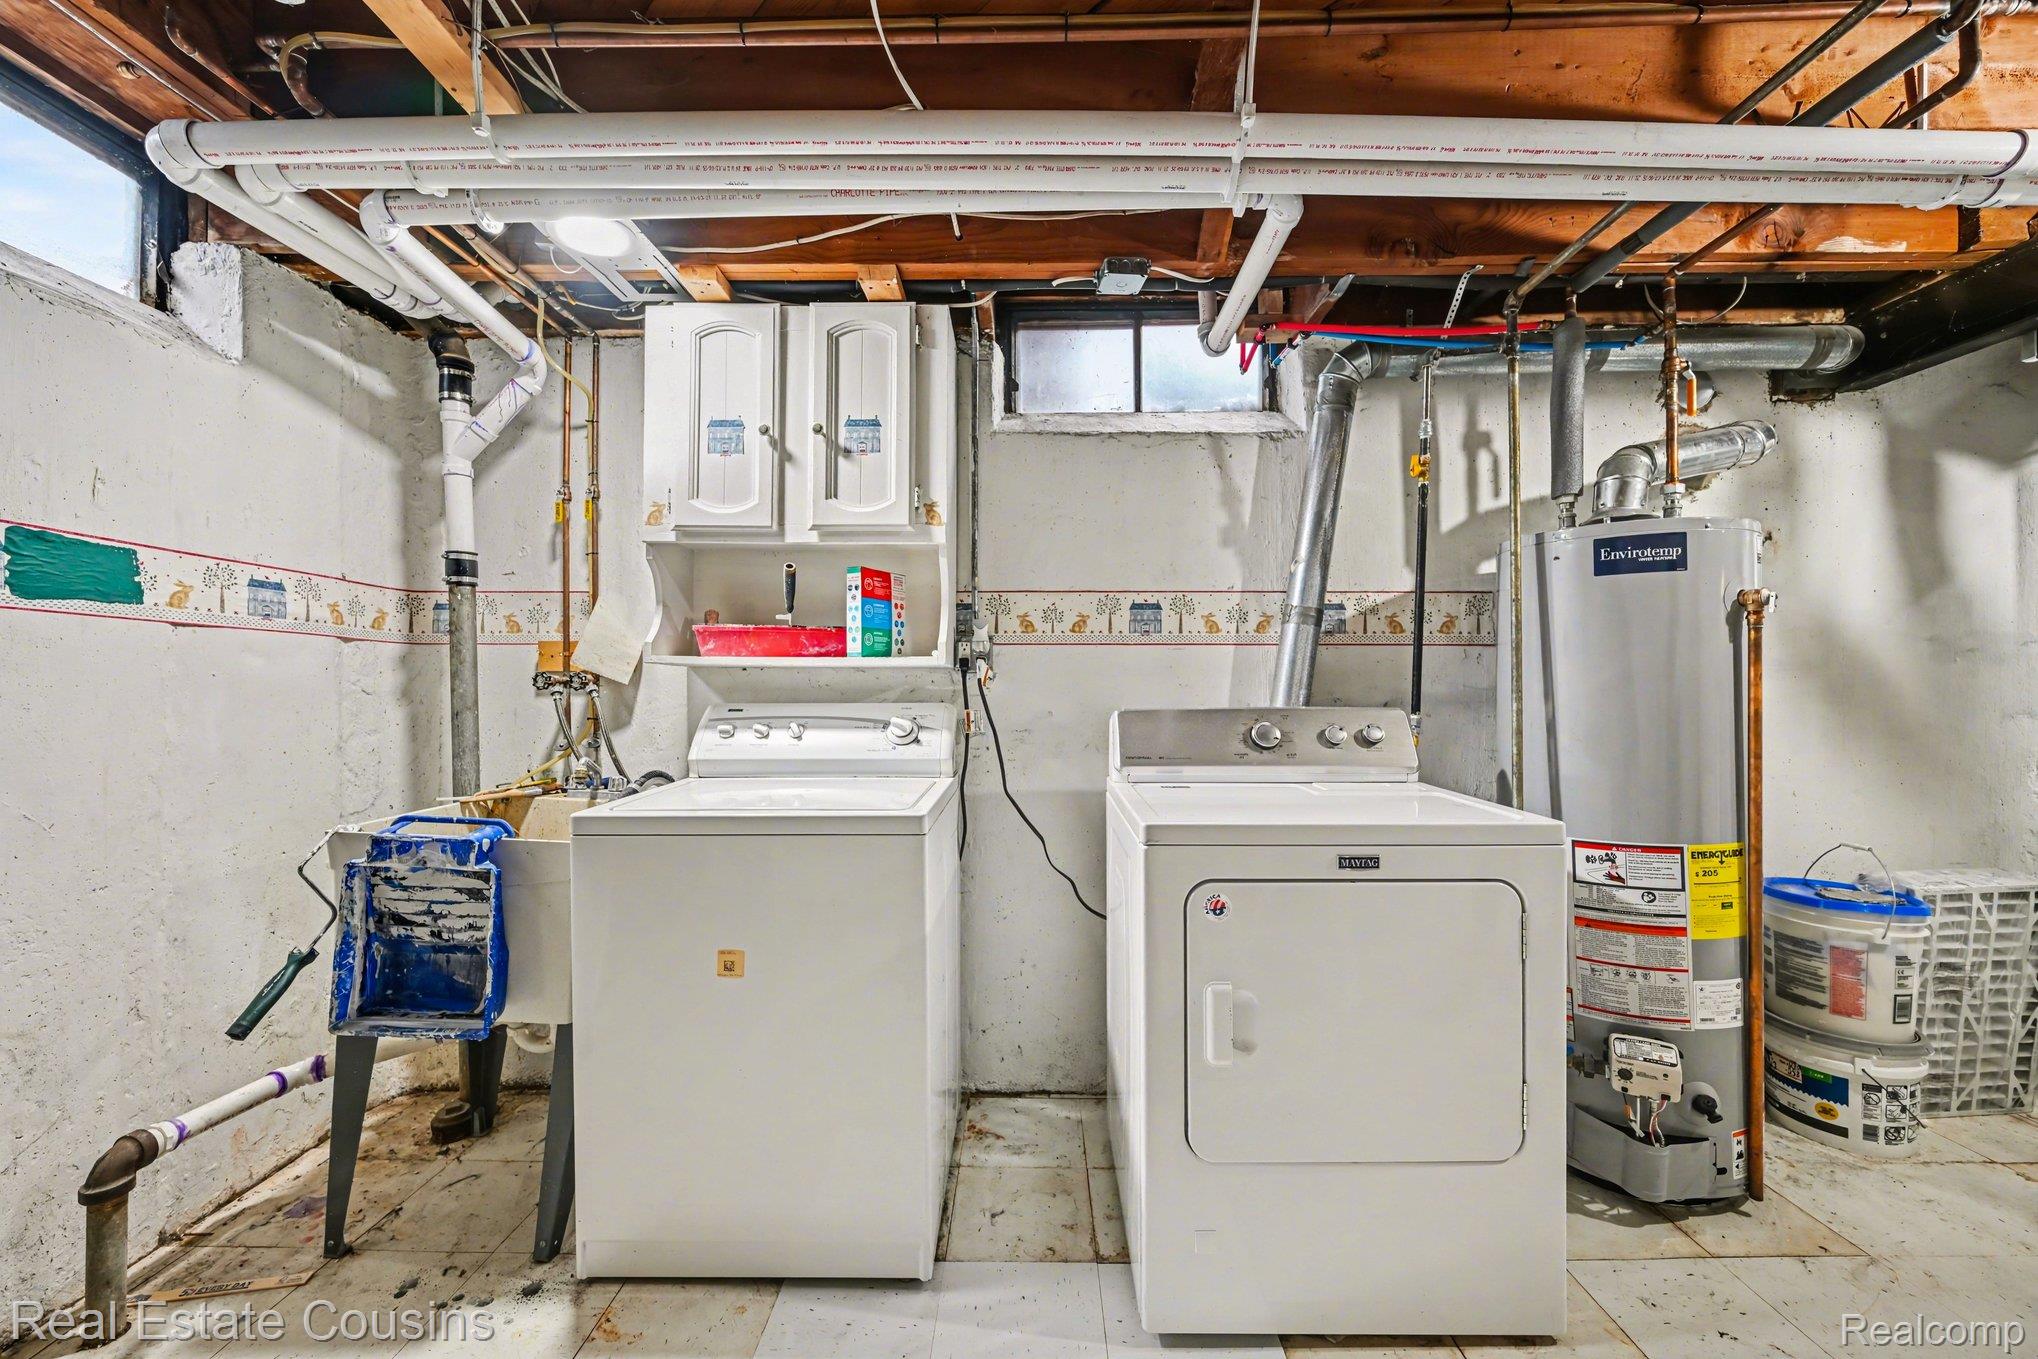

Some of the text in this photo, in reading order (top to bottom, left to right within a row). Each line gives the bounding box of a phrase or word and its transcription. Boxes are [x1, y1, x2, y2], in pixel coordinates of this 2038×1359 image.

[1600, 546, 1682, 561] Envirotemp
[1340, 858, 1378, 867] MAYTAG
[1702, 869, 1719, 877] 205
